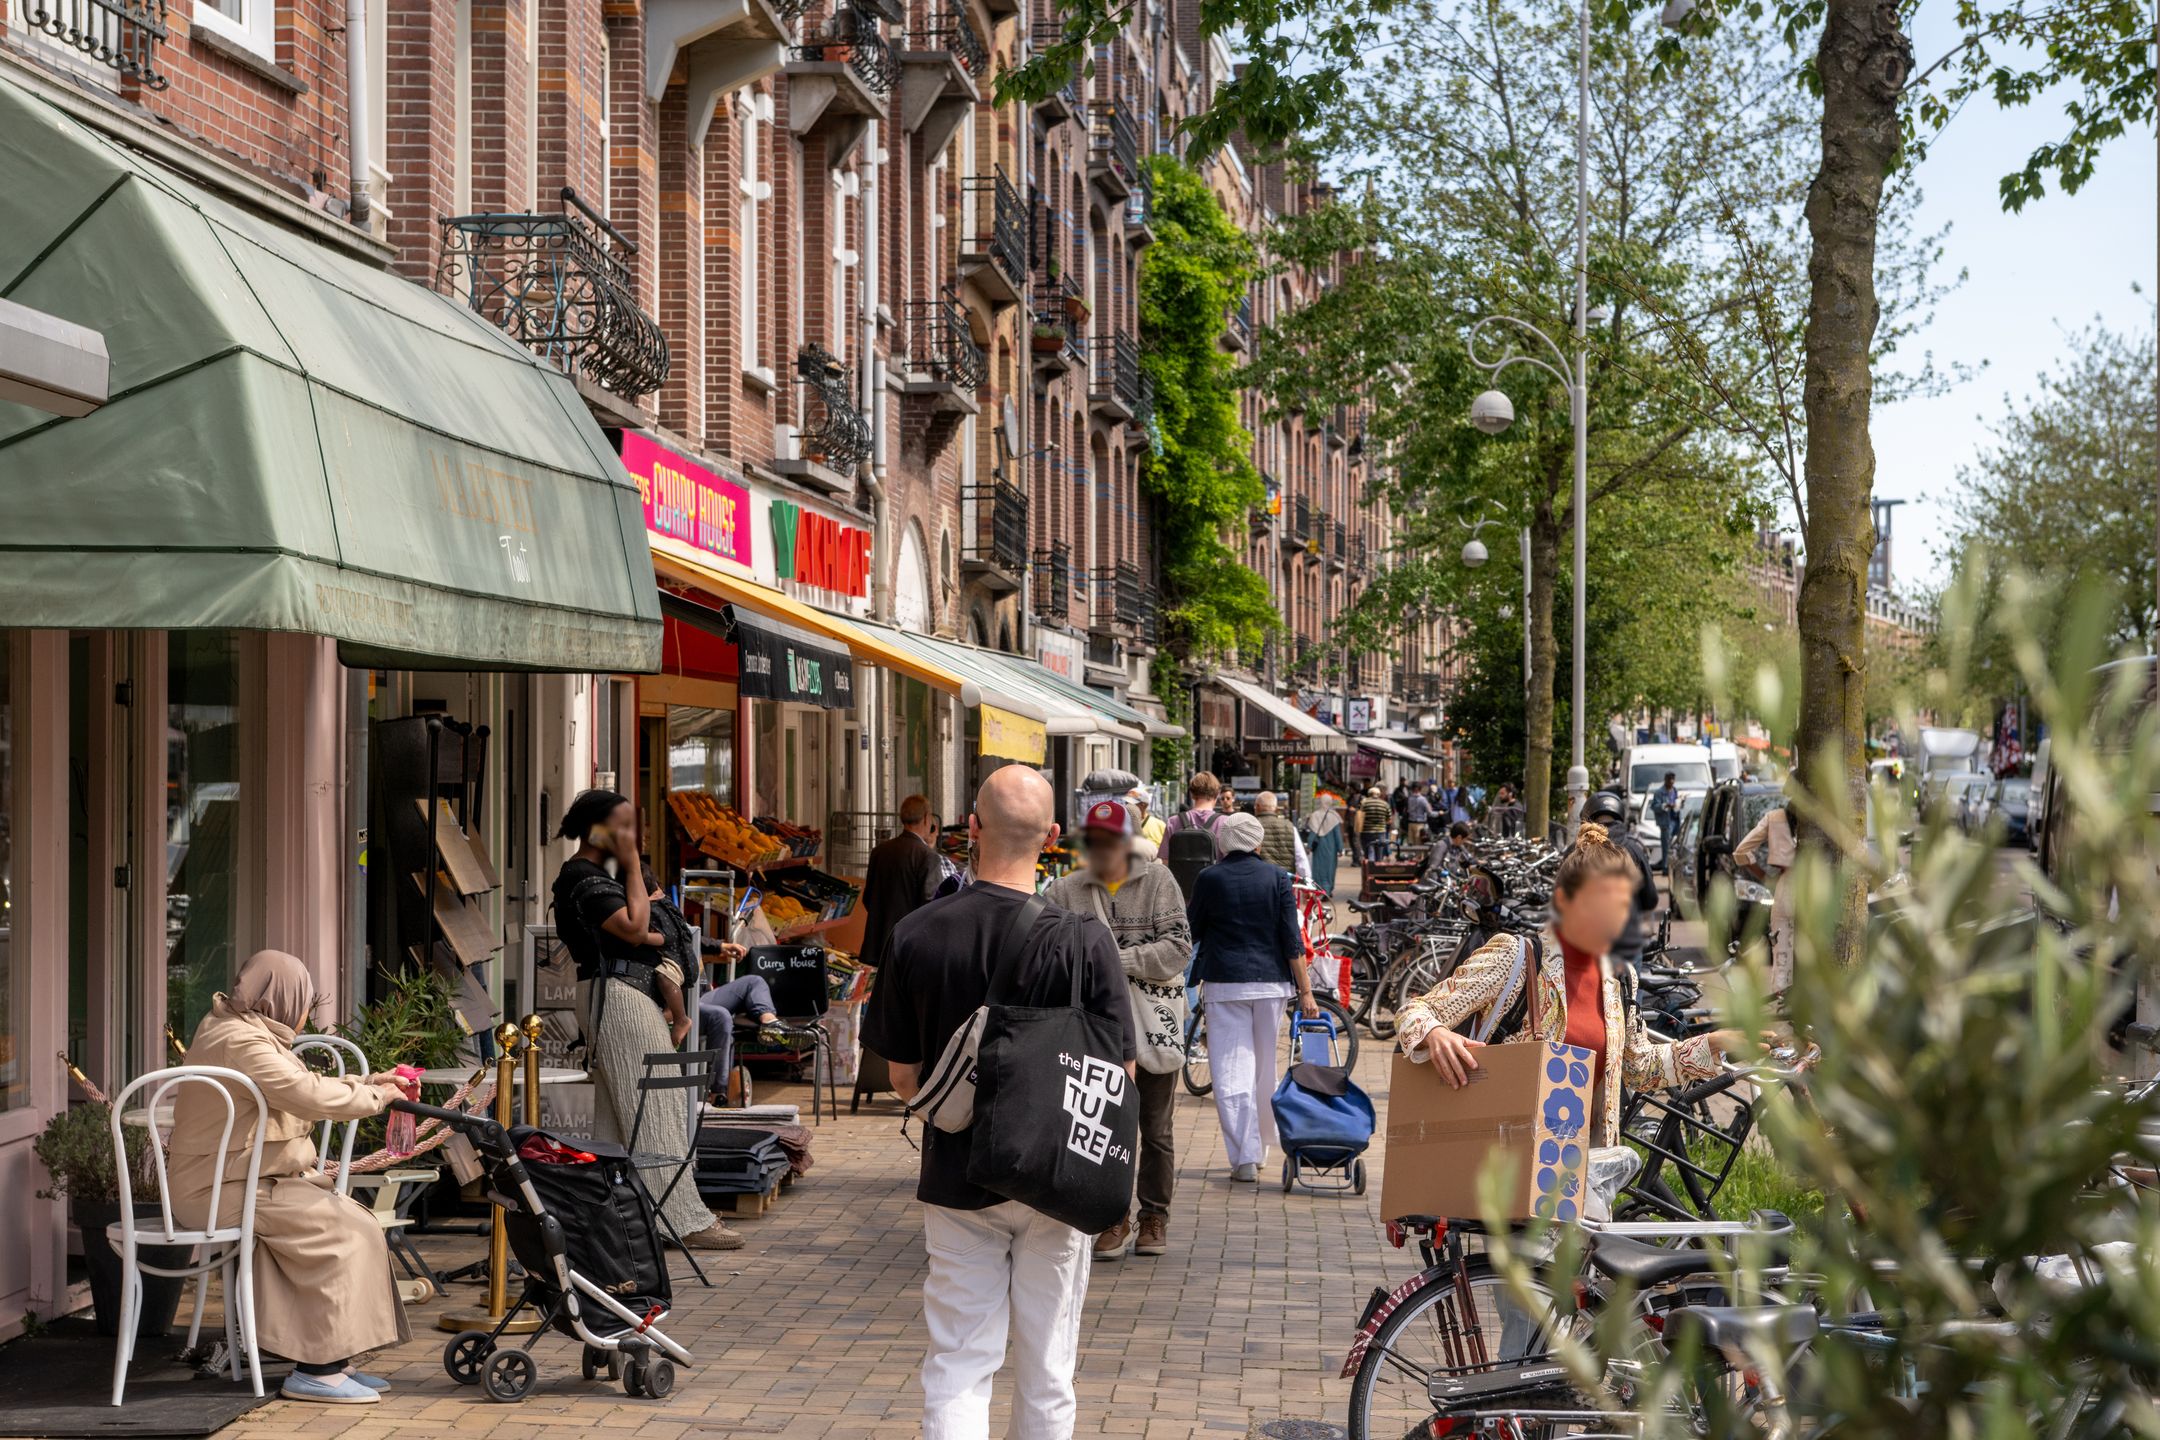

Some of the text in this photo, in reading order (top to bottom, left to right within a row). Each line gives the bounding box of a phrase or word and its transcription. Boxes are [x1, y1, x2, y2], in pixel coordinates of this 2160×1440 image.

[653, 461, 697, 542] CURRY
[698, 483, 737, 559] HOUSE
[771, 499, 870, 598] YAKHLAF
[1260, 741, 1294, 753] Bakkerij
[757, 955, 817, 971] Curry House
[543, 985, 576, 1001] LAM
[1058, 1052, 1082, 1071] the
[541, 1112, 592, 1127] RAAM-
[1108, 1144, 1121, 1159] of
[1119, 1148, 1131, 1165] AI
